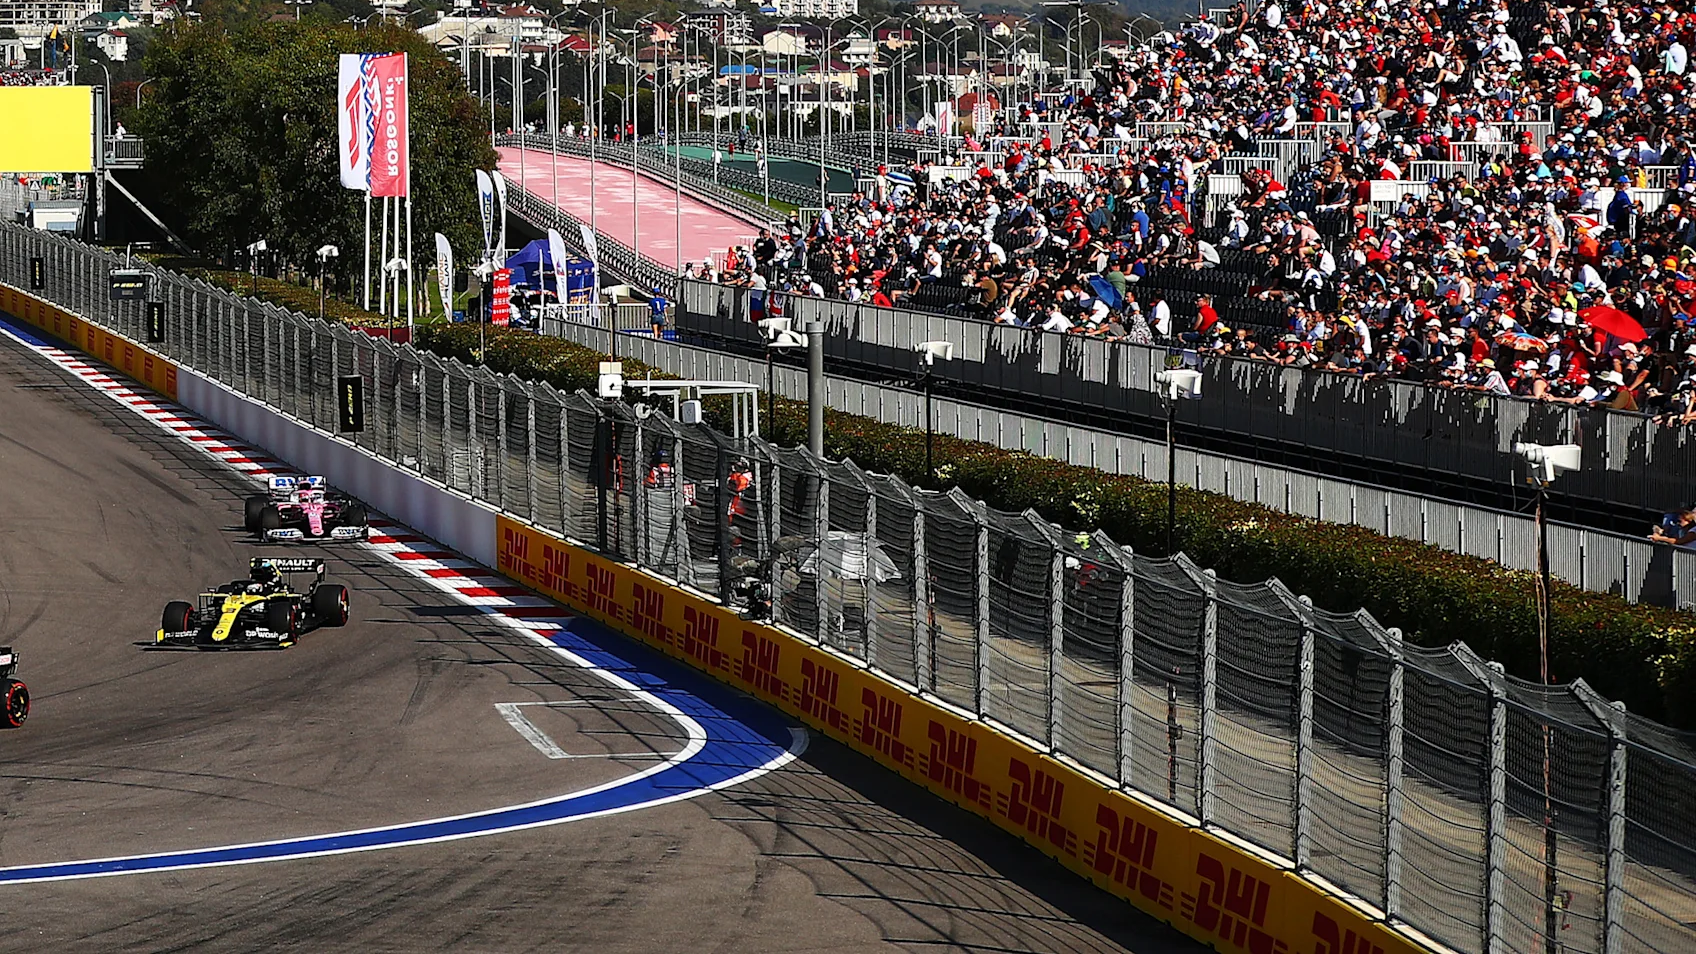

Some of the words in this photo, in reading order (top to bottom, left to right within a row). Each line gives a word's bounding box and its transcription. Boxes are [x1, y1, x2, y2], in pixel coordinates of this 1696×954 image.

[504, 528, 530, 578] DHL
[544, 544, 572, 598] DHL
[586, 562, 618, 618] DHL
[632, 582, 666, 642] DHL
[684, 606, 722, 668] DHL
[742, 630, 782, 698] DHL
[800, 658, 840, 730] DHL
[862, 688, 904, 764] DHL
[929, 720, 980, 802] DHL
[1008, 757, 1066, 850] DHL
[1094, 804, 1162, 902] DHL
